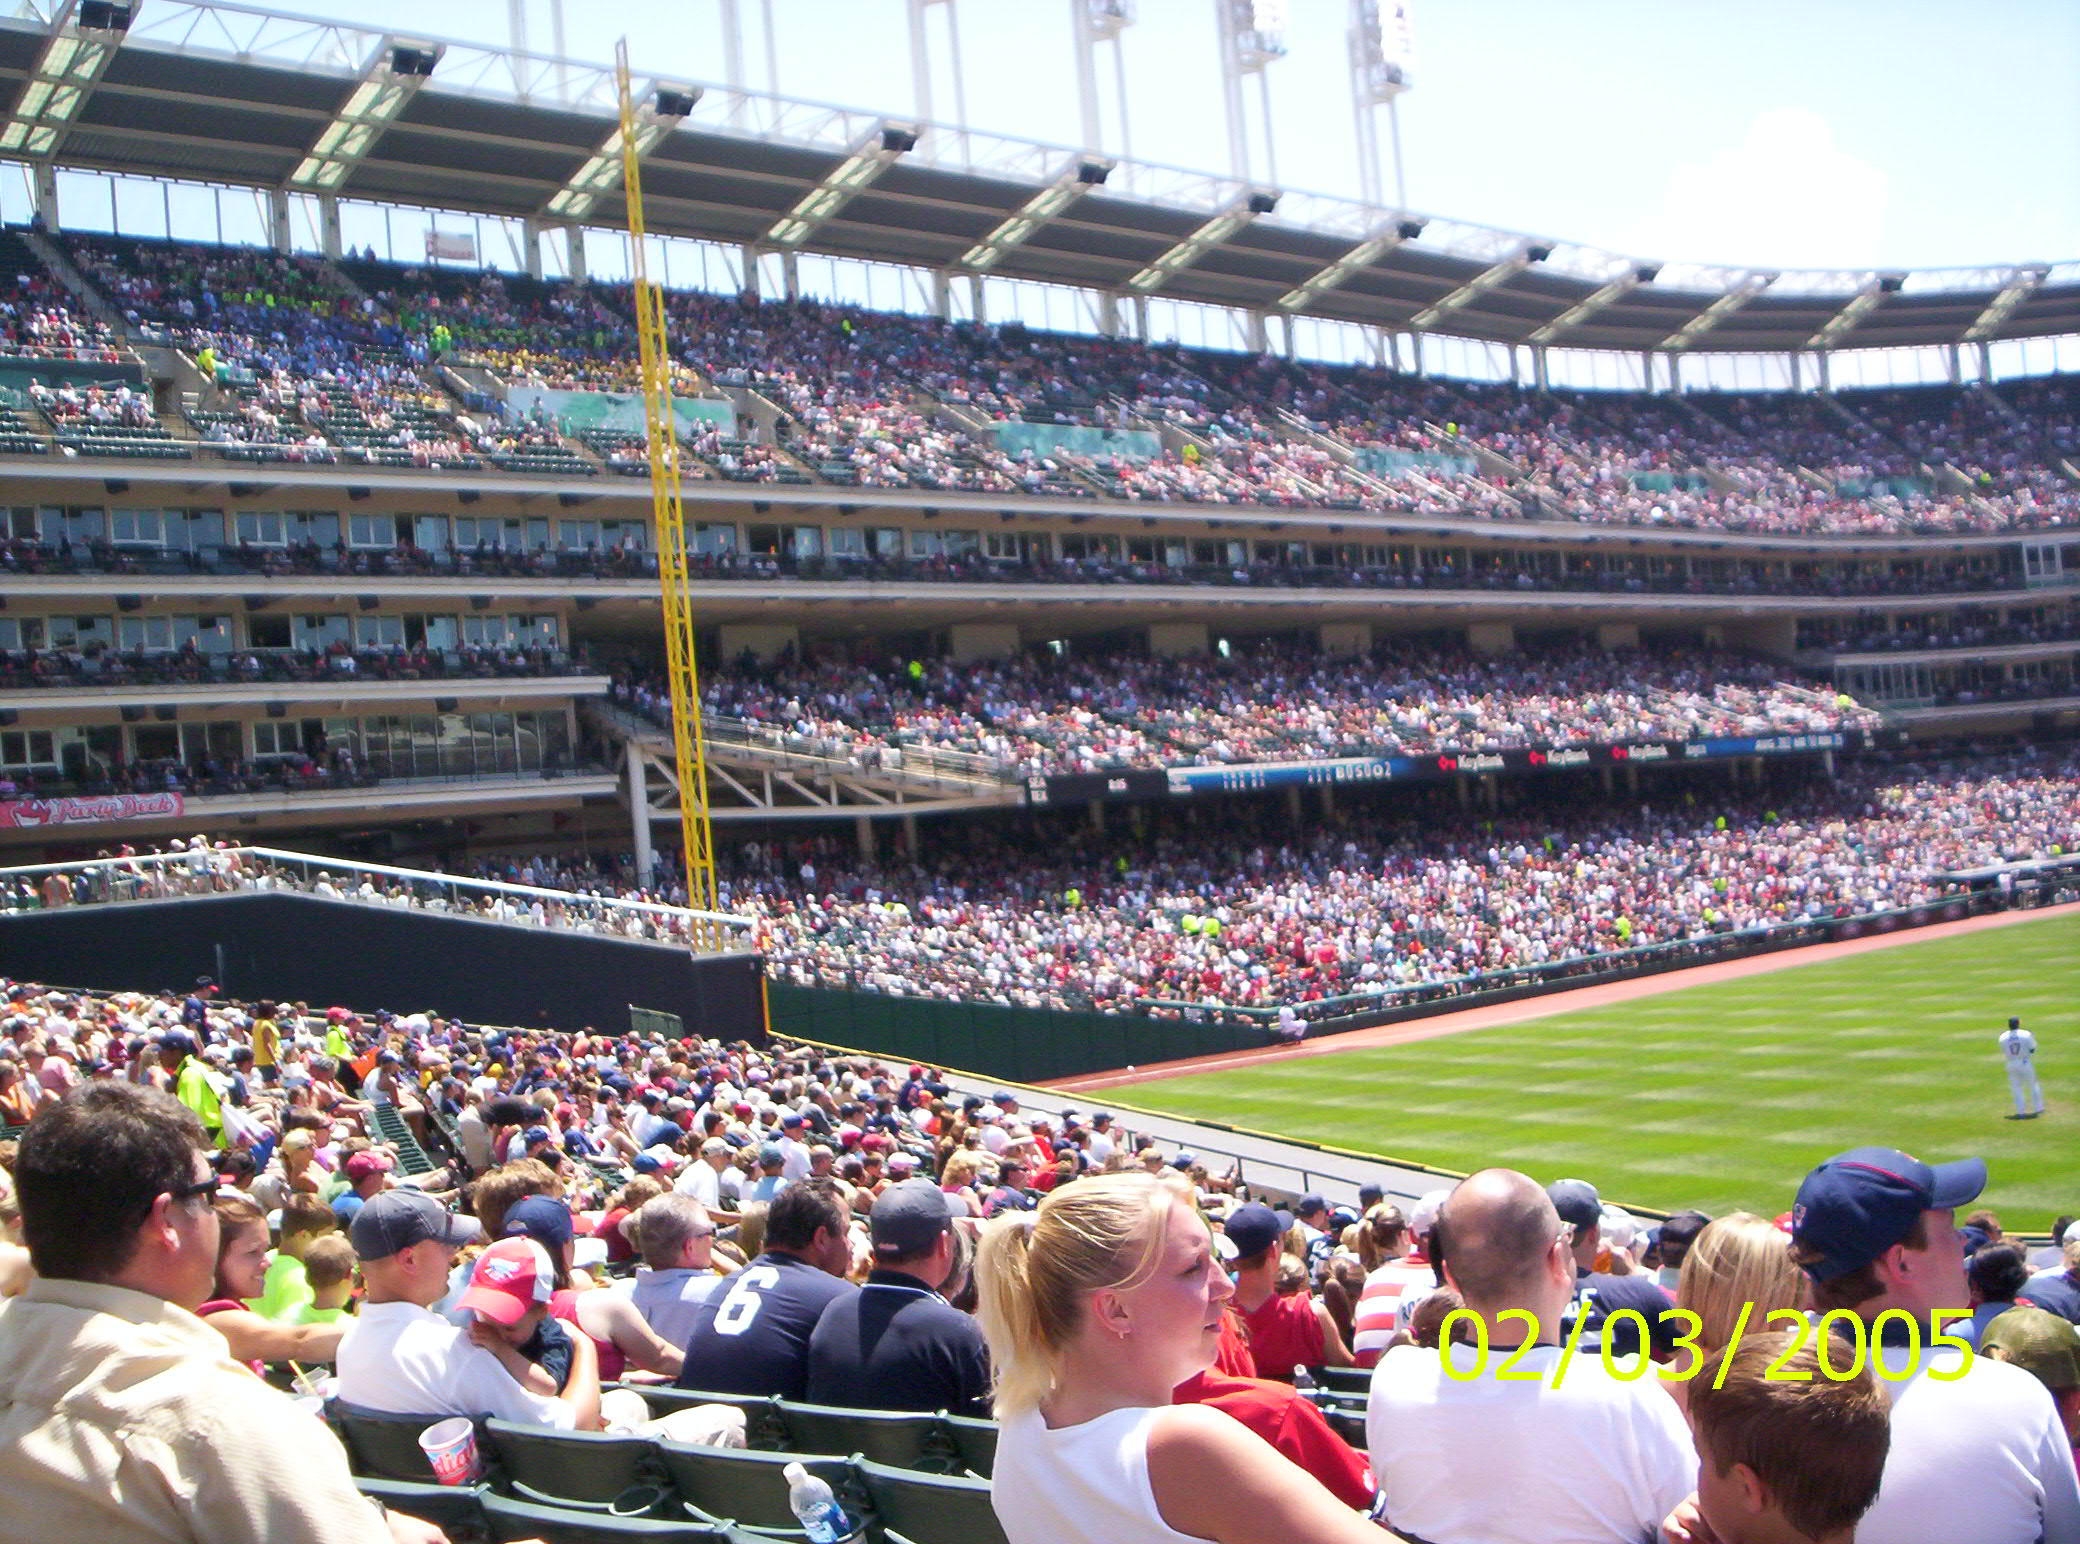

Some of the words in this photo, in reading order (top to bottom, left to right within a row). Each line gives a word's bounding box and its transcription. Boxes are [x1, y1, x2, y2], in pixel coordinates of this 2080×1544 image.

[1458, 753, 1504, 771] KeyBank
[1547, 749, 1590, 767] KeyBank
[54, 798, 113, 823] Party
[112, 793, 174, 819] Deck
[713, 1266, 780, 1335] 6
